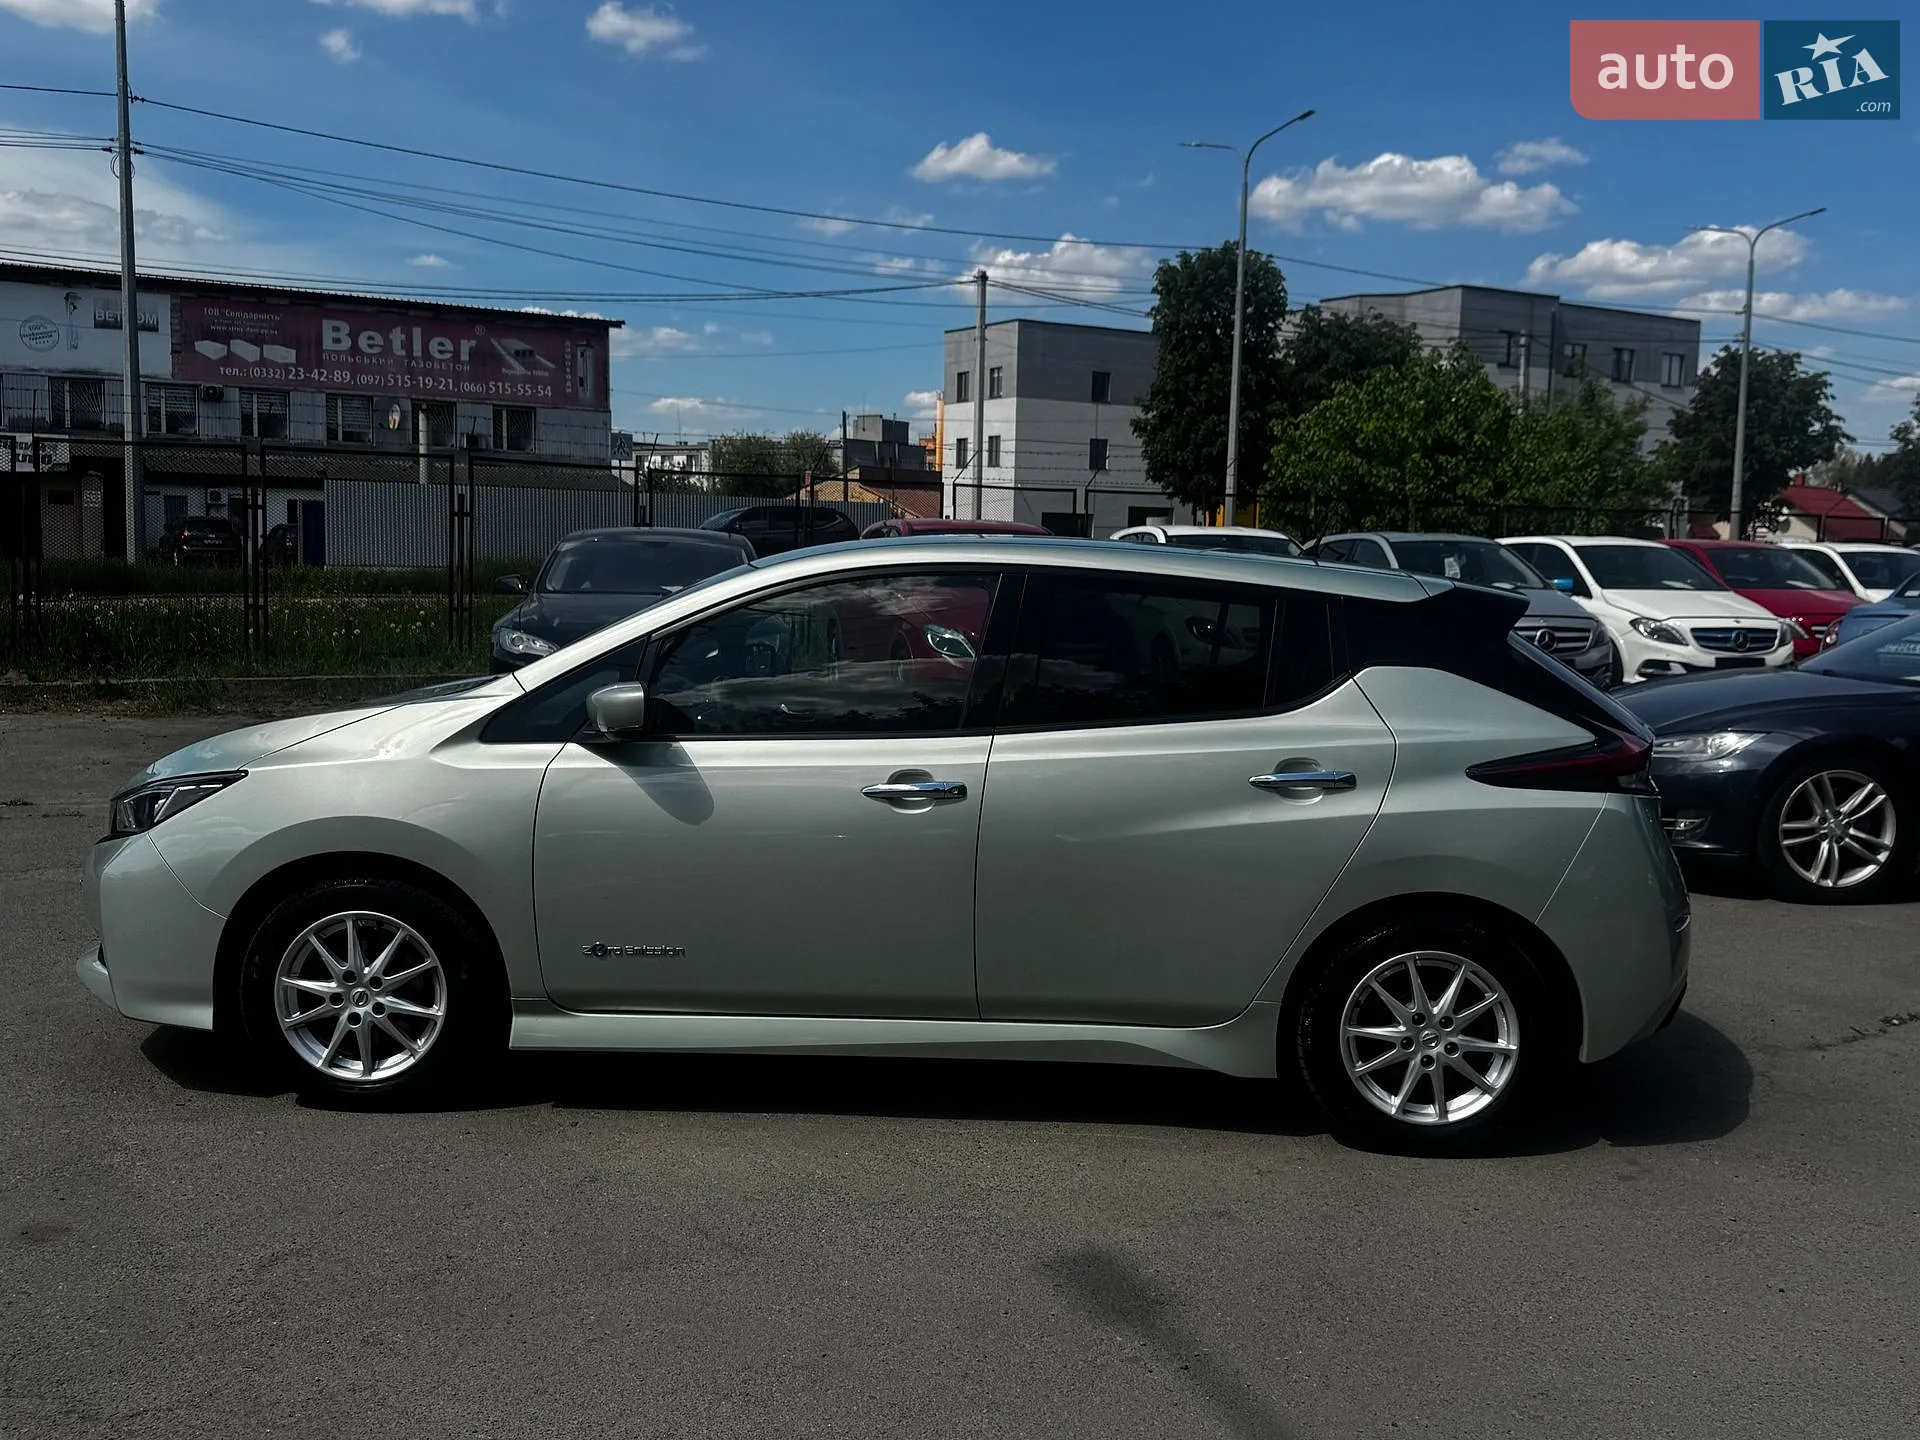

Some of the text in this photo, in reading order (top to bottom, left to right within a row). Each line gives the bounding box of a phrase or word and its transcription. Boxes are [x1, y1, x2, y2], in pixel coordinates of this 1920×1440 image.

[321, 319, 477, 361] Betler
[249, 366, 286, 379] (0332)
[287, 366, 354, 385] 23-42-89,
[356, 374, 385, 386] (097)
[387, 374, 458, 392] 515-19-21,
[459, 382, 487, 394] (066)
[488, 382, 552, 398] 515-55-54
